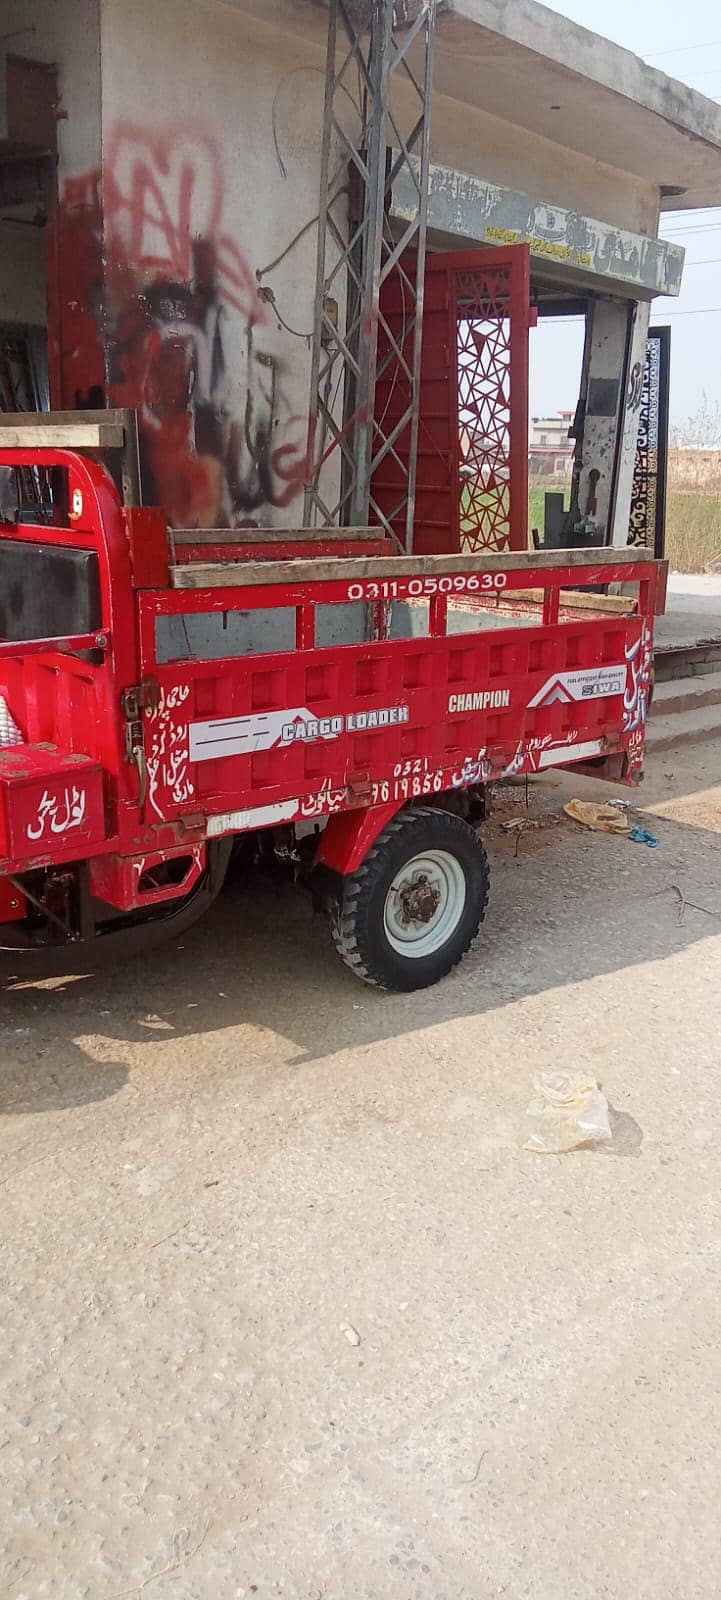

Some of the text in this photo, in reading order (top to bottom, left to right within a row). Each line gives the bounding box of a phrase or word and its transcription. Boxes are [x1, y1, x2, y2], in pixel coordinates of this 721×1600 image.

[347, 573, 507, 600] 0311-0509630
[581, 681, 621, 696] SIWA
[448, 689, 510, 713] CHAMPION
[281, 705, 410, 741] CARGO LOADER
[393, 757, 428, 778] 0321
